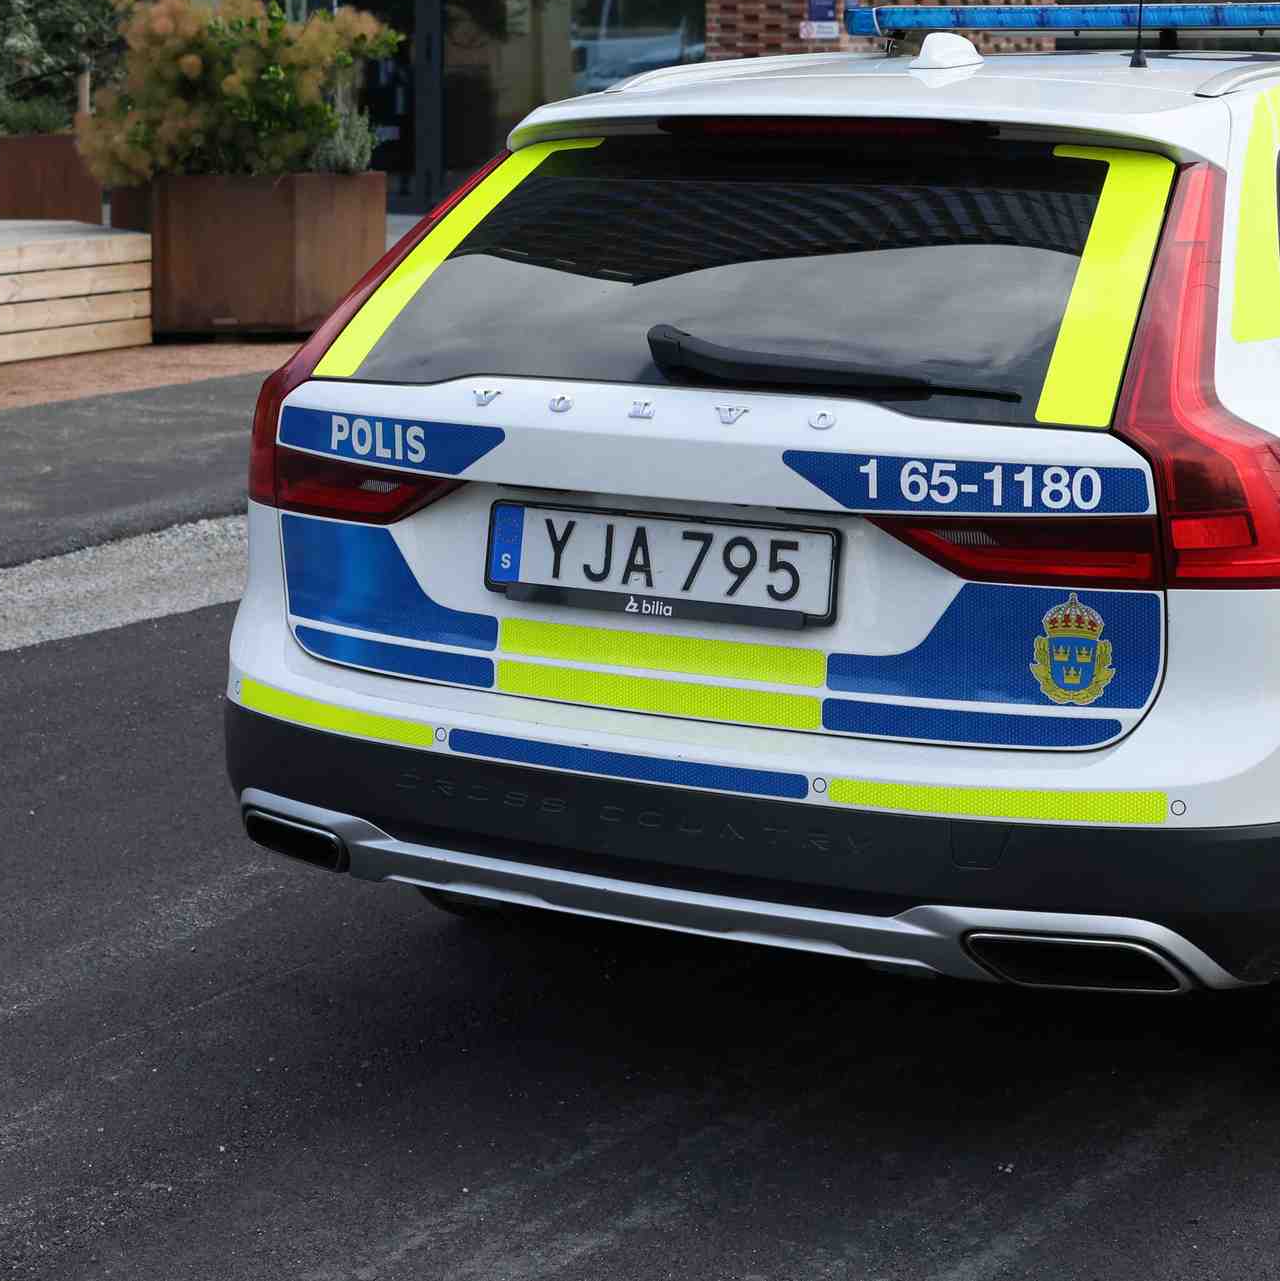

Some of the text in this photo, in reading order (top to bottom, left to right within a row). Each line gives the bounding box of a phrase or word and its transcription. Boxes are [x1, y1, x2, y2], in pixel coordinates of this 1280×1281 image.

[473, 389, 836, 430] VOLVO
[331, 415, 426, 464] POLIS
[859, 459, 1102, 510] 1 65-1180
[500, 553, 511, 569] S
[544, 518, 801, 602] YJA 795
[641, 598, 673, 617] bilia
